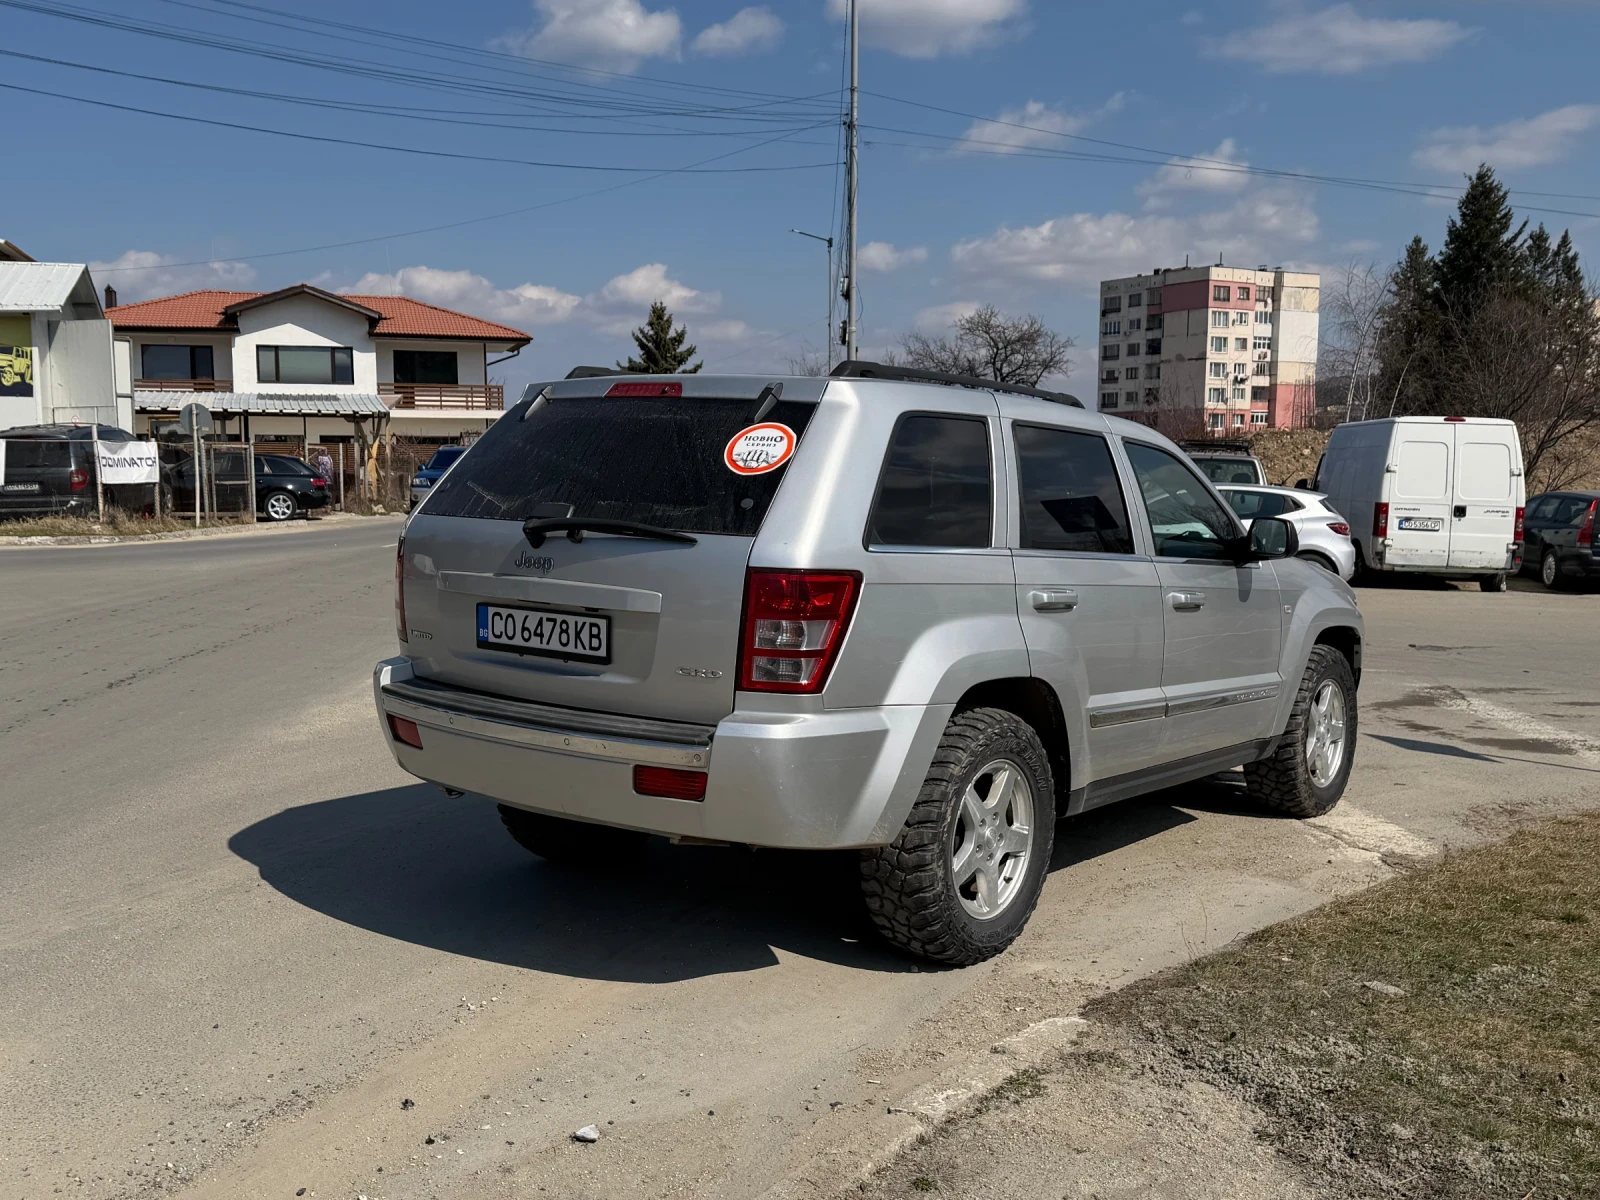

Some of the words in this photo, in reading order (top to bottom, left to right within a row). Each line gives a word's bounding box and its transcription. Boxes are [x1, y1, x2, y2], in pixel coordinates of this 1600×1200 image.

[1413, 521, 1430, 529] 5356
[514, 551, 555, 574] Jeep
[479, 629, 488, 638] BG
[520, 613, 571, 648] 6478
